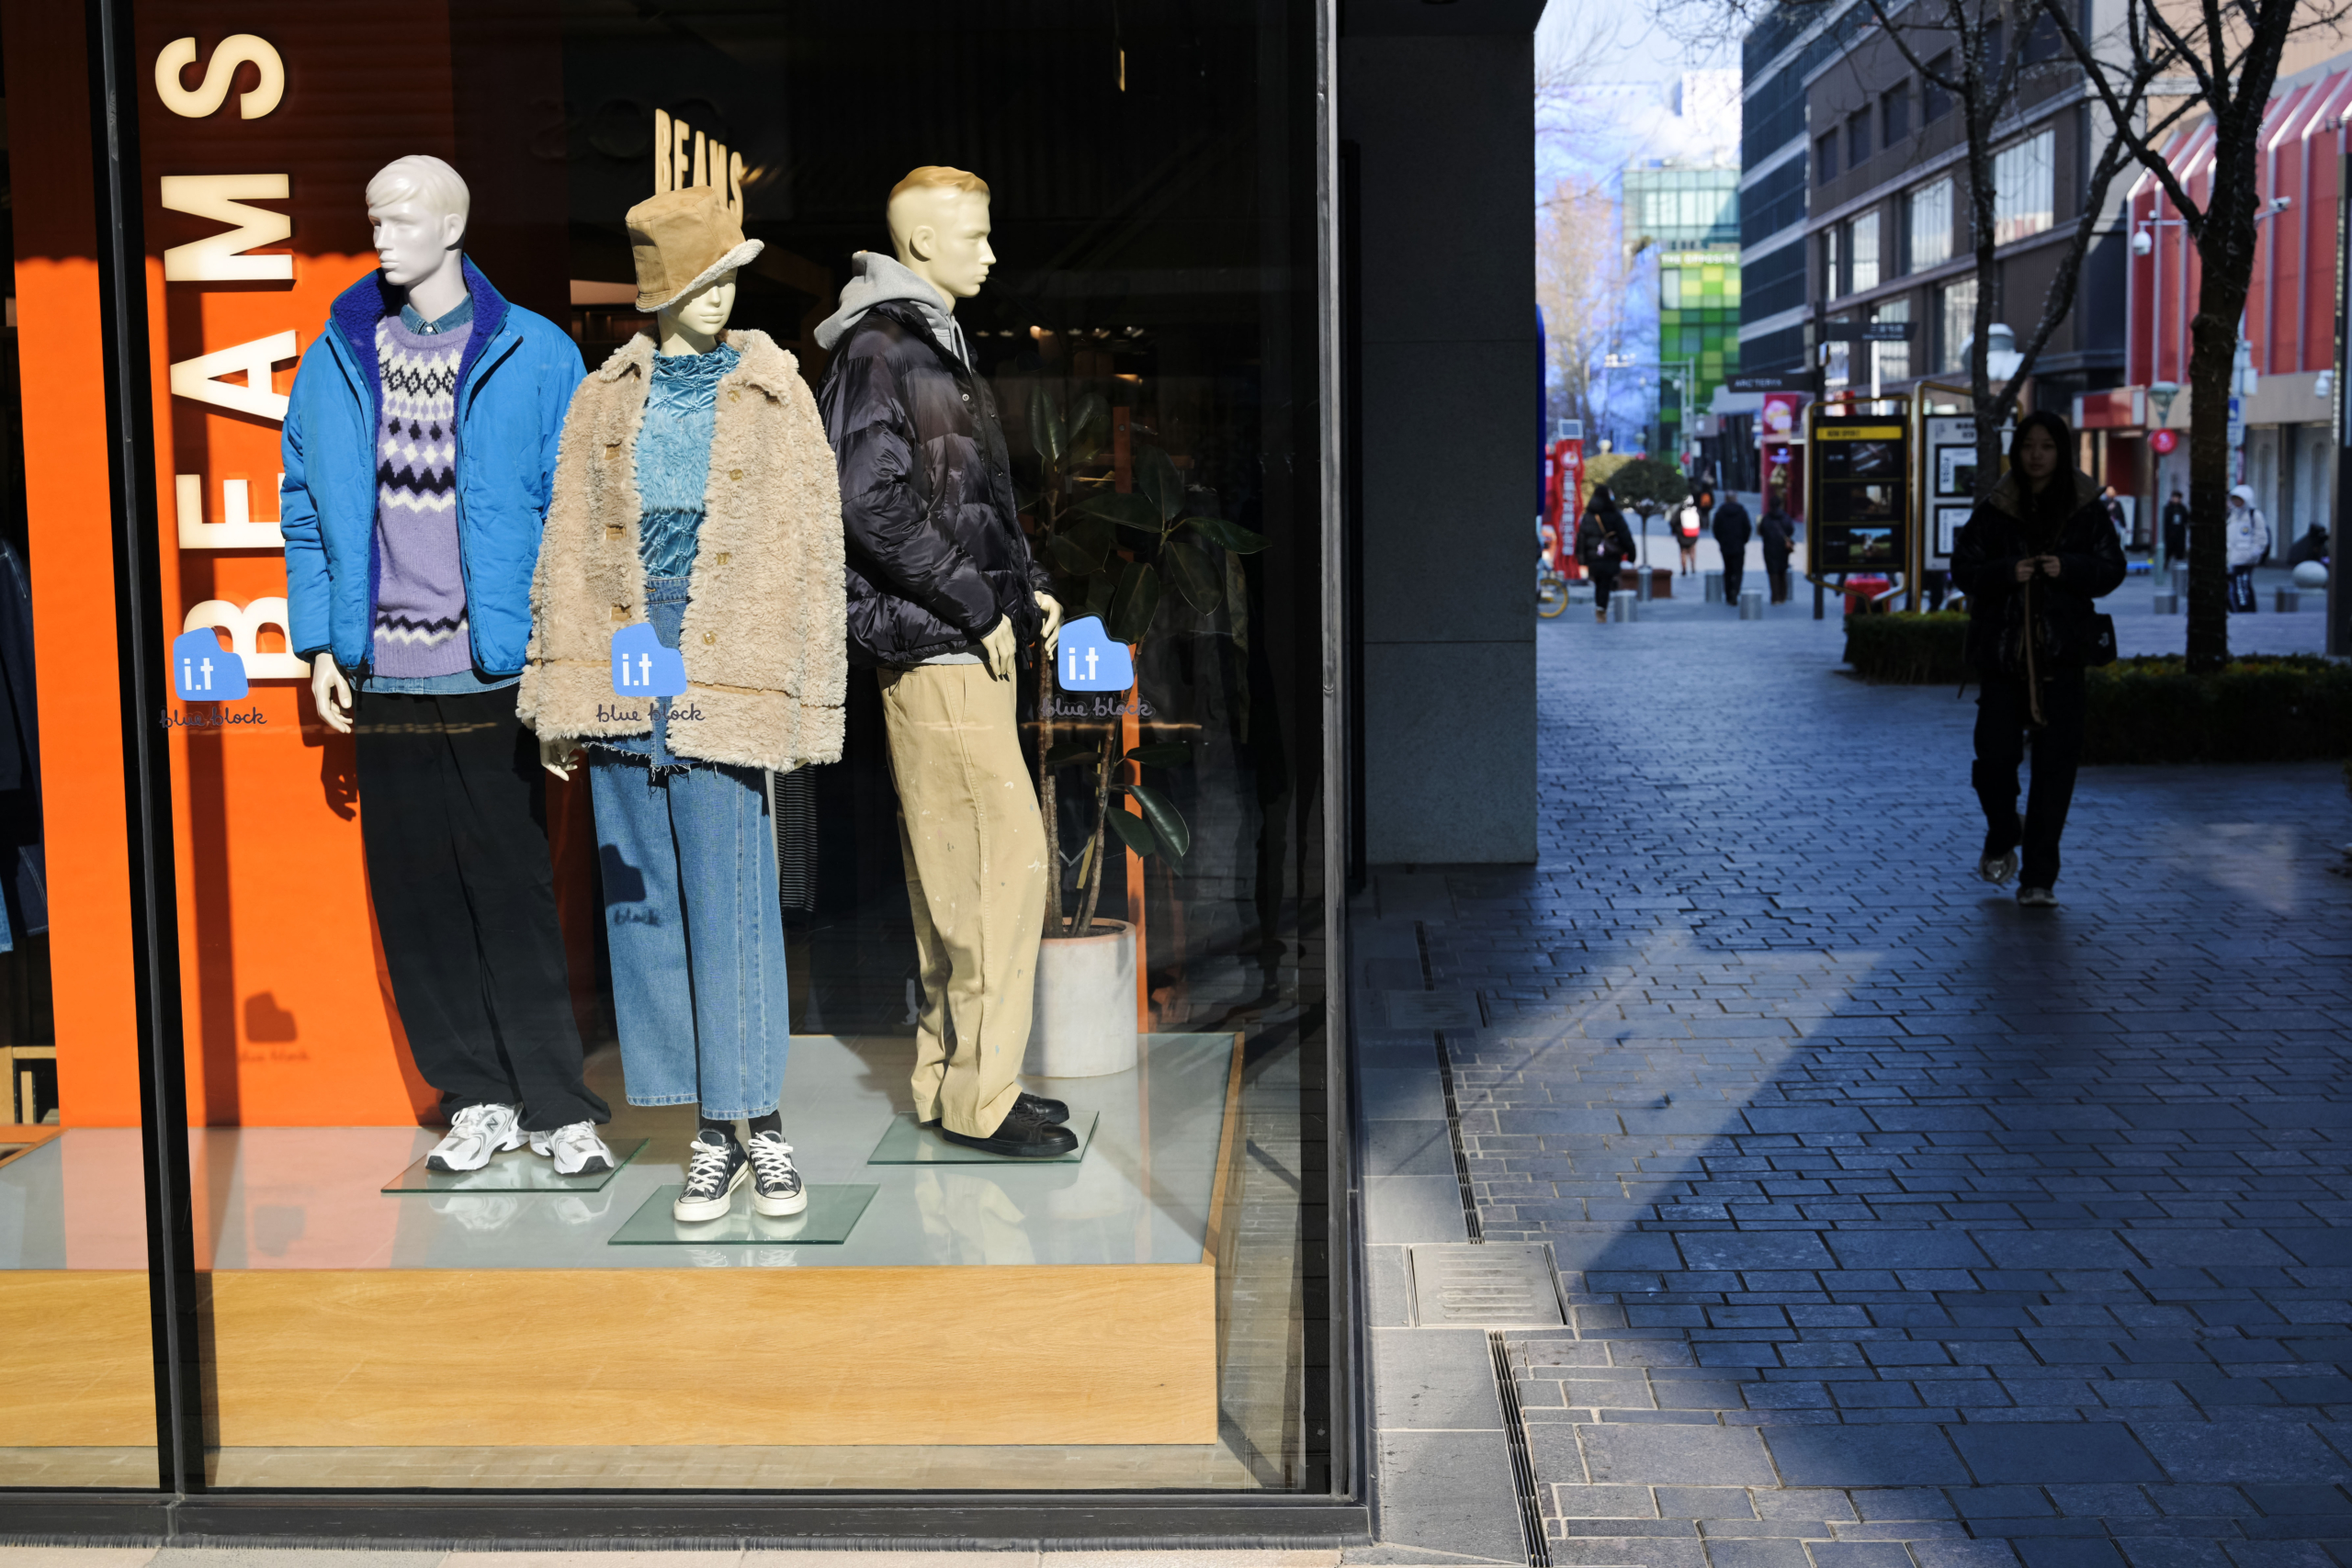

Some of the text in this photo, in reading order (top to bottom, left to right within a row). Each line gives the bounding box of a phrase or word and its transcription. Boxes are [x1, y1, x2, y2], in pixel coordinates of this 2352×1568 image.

[655, 108, 744, 228] BEAMS
[155, 33, 311, 679] BEAMS
[184, 658, 213, 691] i.t
[622, 653, 652, 686] i.t
[1069, 647, 1099, 681] i.t
[159, 706, 268, 728] blue block
[596, 703, 706, 723] blue block
[1040, 696, 1153, 716] blue block
